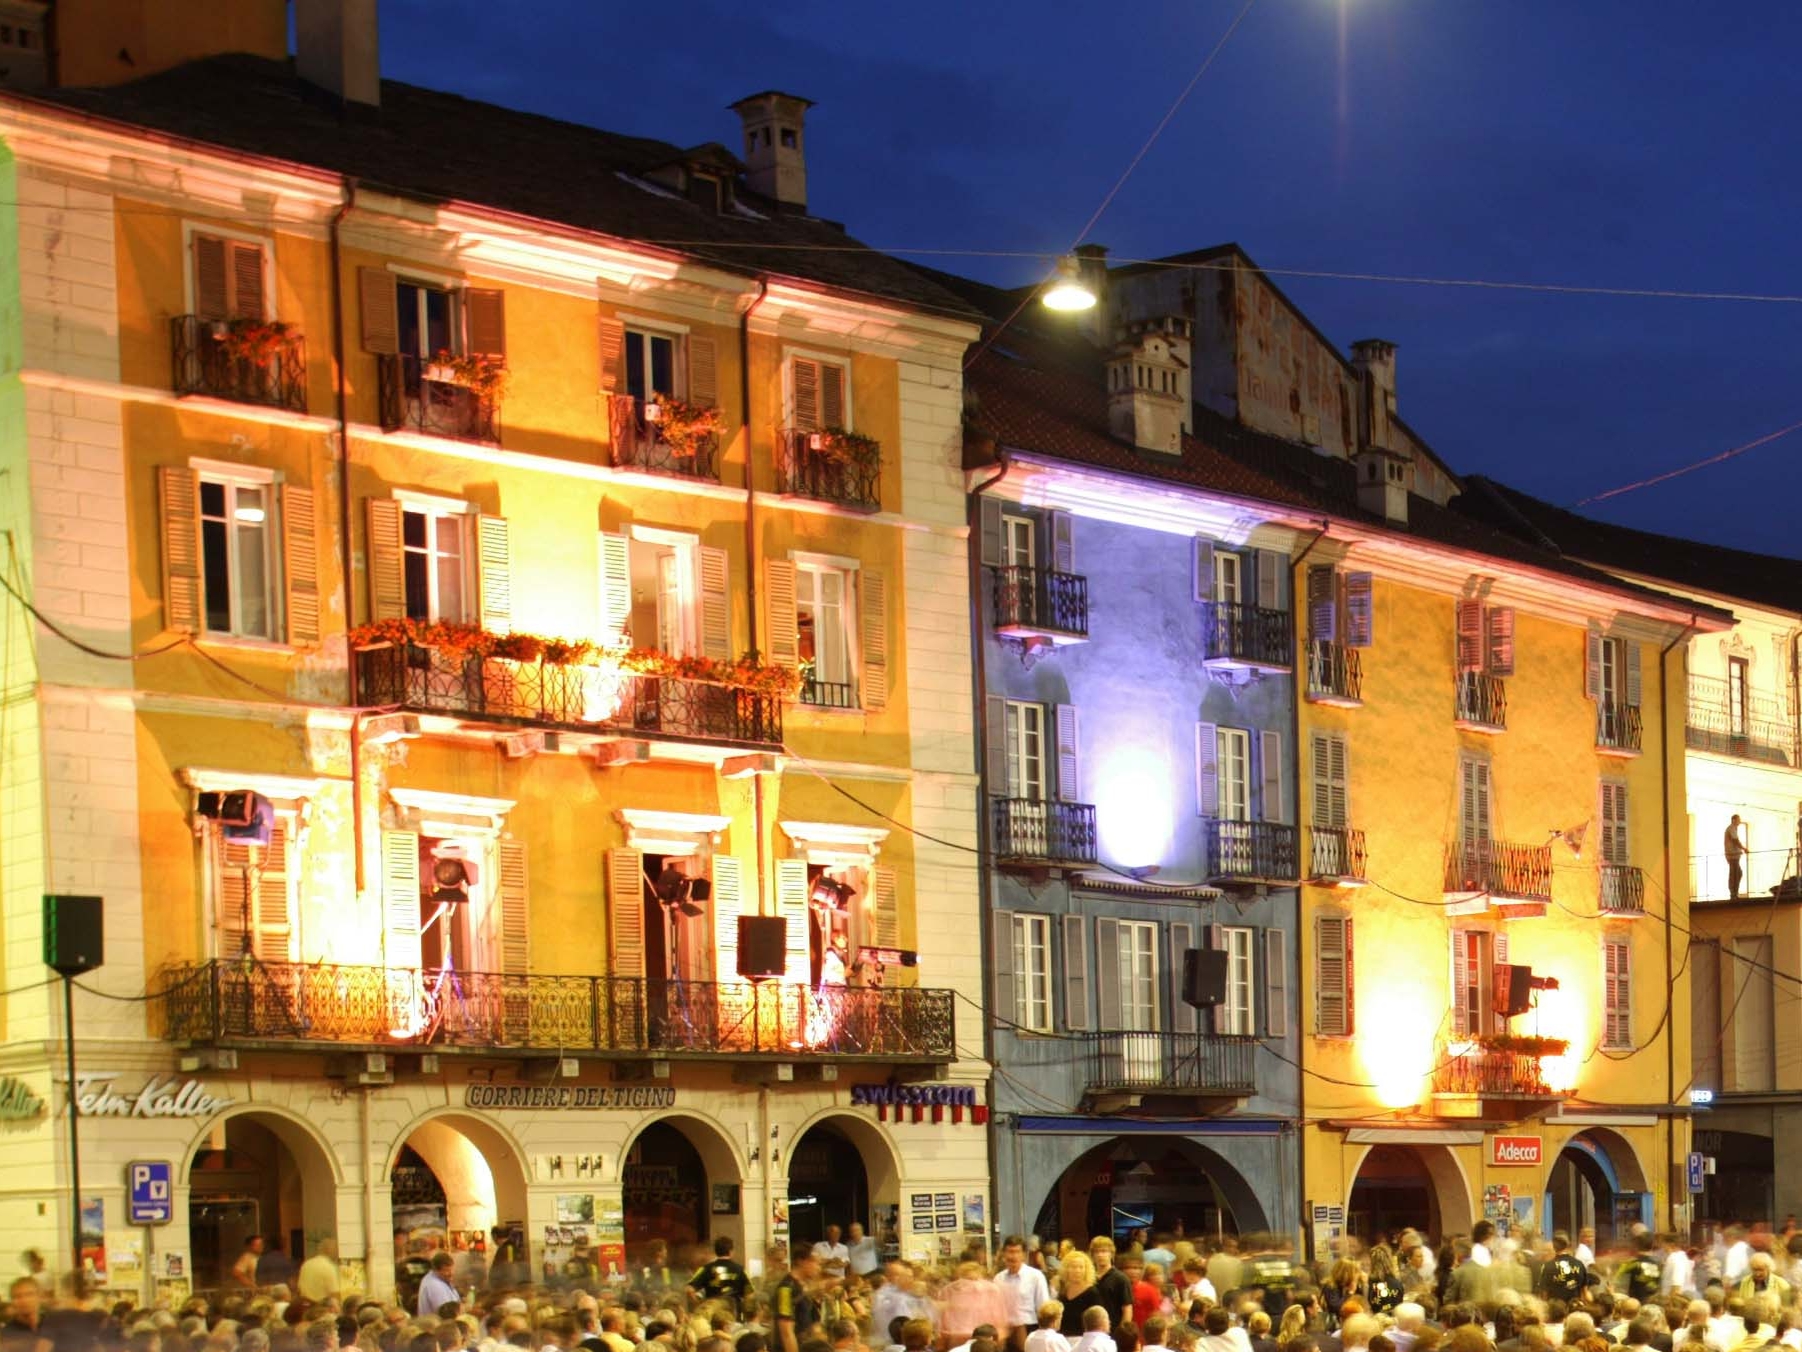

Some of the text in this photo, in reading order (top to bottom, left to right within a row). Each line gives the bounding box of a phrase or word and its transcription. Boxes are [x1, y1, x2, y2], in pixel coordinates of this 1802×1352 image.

[470, 1086, 676, 1107] CORRIERE DEL TICINO
[852, 1086, 976, 1107] swisscom
[1497, 1143, 1538, 1160] Adecco
[134, 1166, 150, 1191] P
